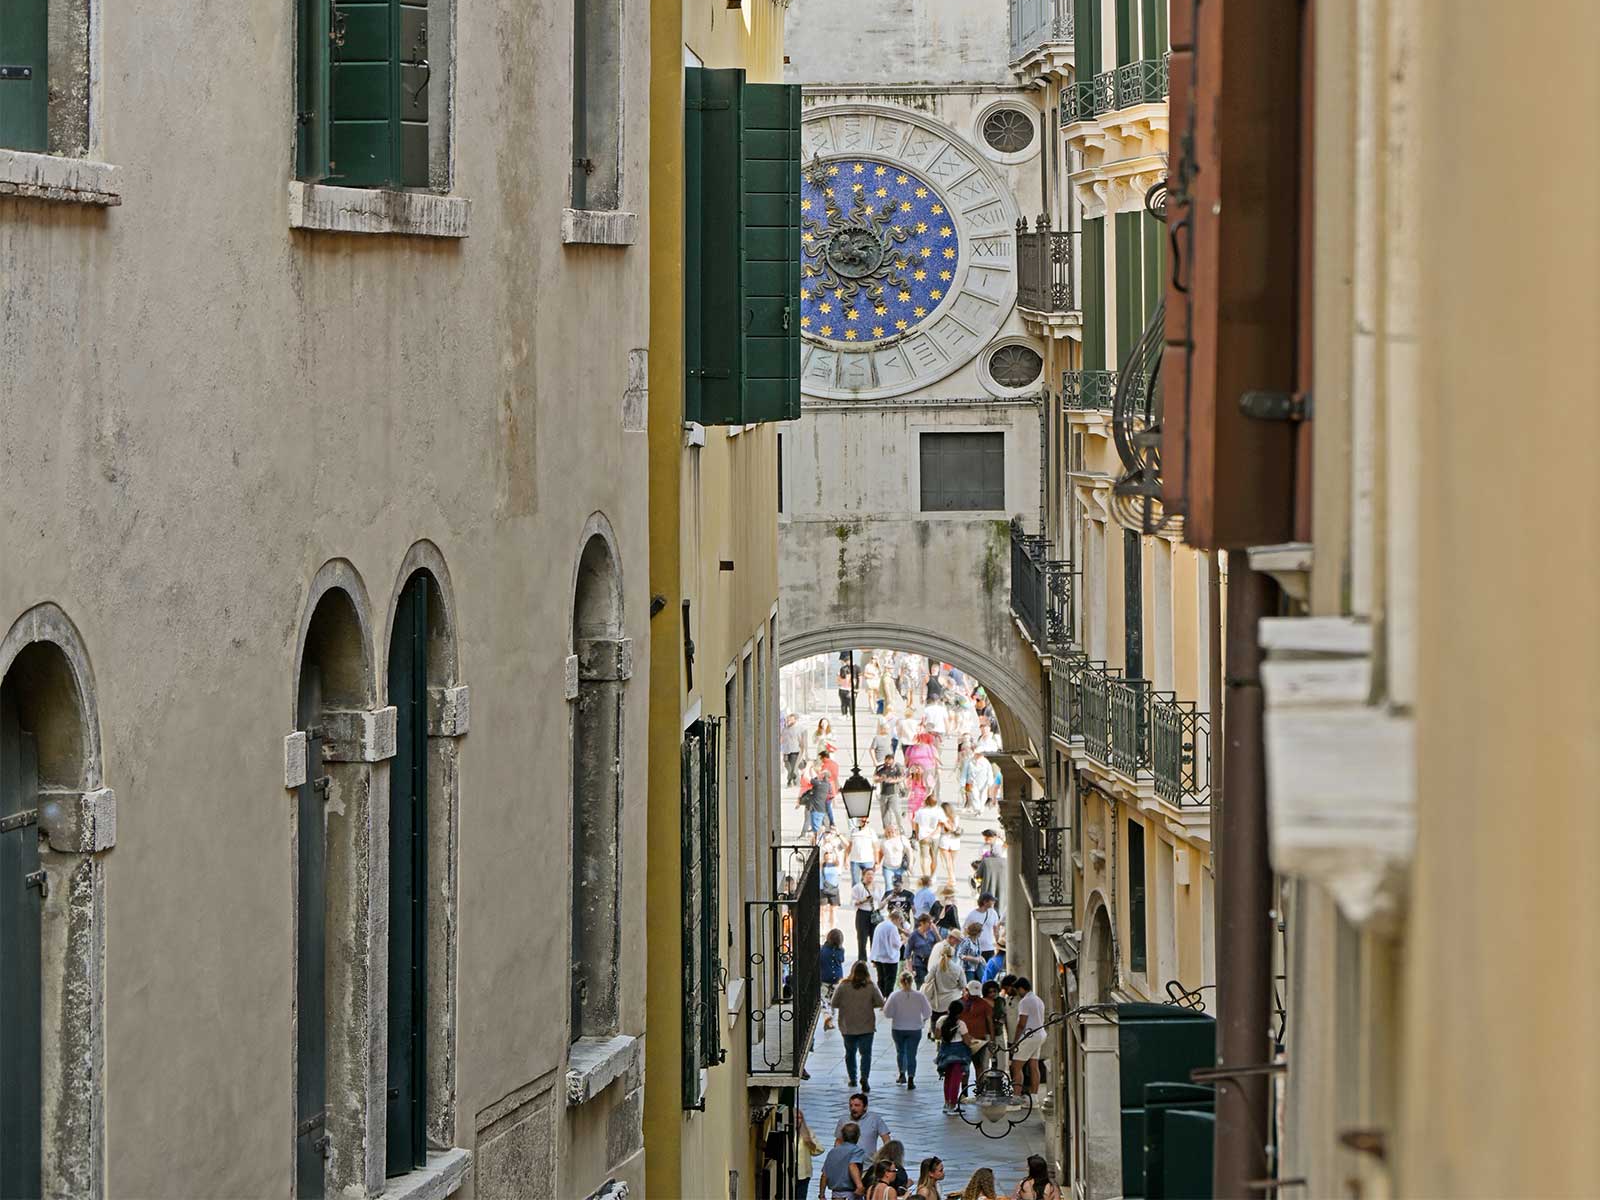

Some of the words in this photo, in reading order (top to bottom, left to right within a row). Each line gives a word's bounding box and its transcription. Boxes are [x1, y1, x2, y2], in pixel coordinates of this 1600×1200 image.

[931, 150, 967, 183] XXI
[965, 207, 1006, 231] XXIII
[971, 242, 1011, 258] XXIIII
[938, 322, 965, 346] III
[884, 355, 901, 368] V
[912, 341, 938, 367] IIII
